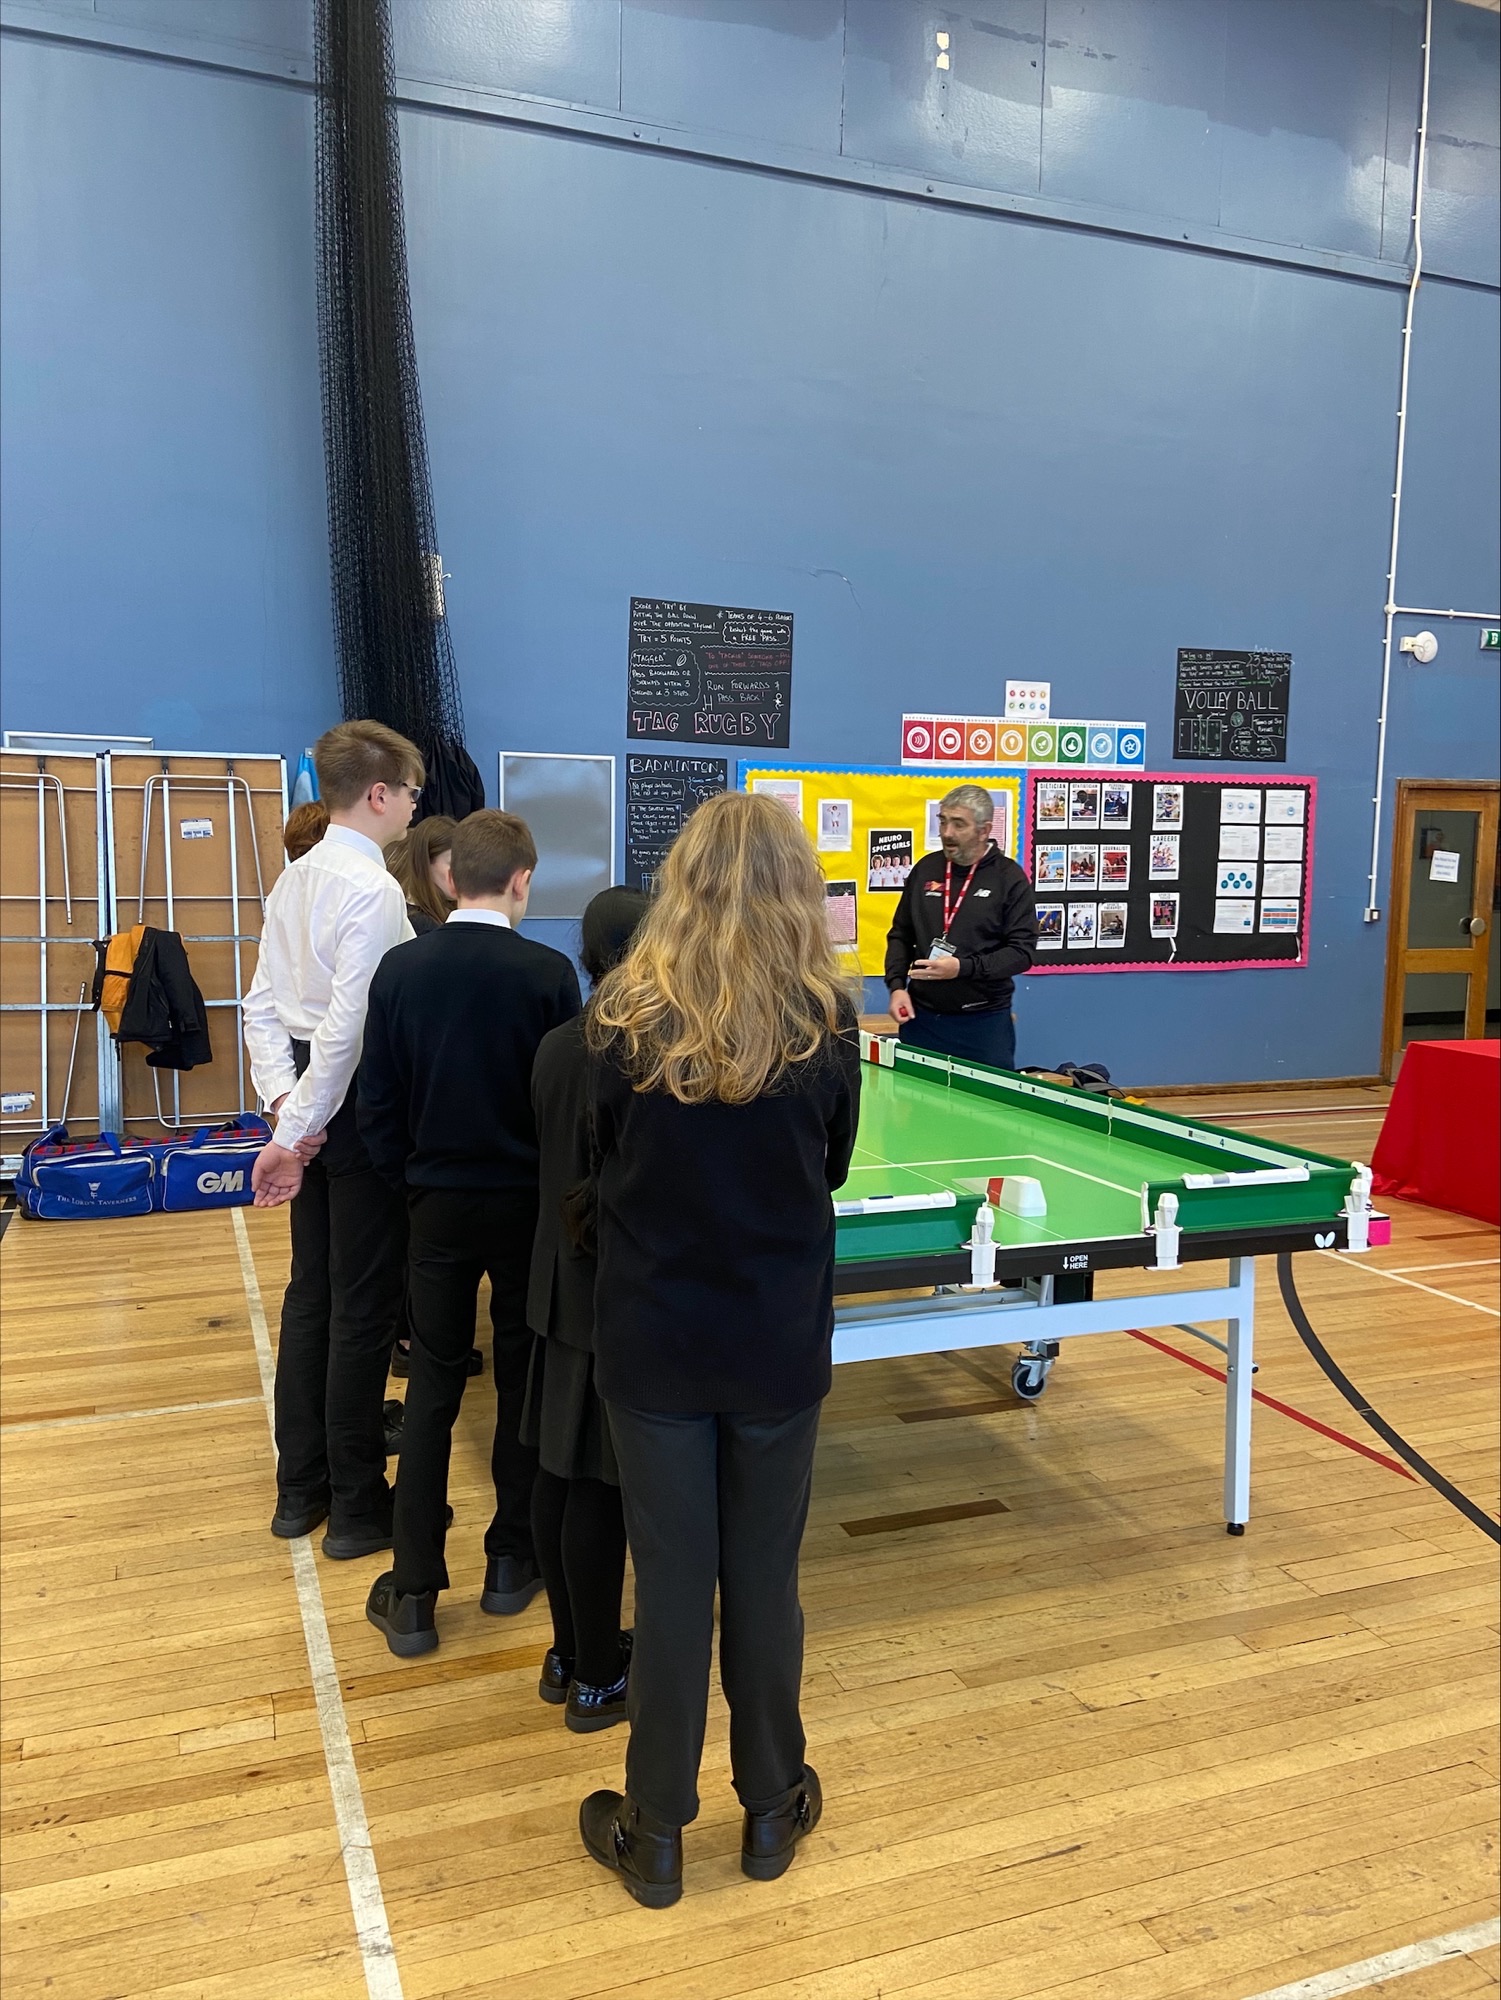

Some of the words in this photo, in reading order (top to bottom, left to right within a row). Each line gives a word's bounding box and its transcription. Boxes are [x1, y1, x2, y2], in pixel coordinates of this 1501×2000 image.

[725, 610, 745, 619] TEAMS
[637, 634, 652, 643] TRY
[660, 634, 667, 644] 5
[670, 634, 692, 645] POINTS
[706, 680, 724, 691] RUN
[730, 679, 770, 690] FORWARDS
[663, 688, 670, 697] 3
[718, 693, 734, 702] PASS
[1185, 690, 1231, 710] VOLLEY
[1237, 691, 1279, 710] BALL
[632, 710, 679, 733] TAG
[694, 711, 781, 740] RUGBY
[878, 834, 902, 844] NEURO
[872, 844, 891, 853] SPICE
[891, 841, 911, 850] GIRLS
[1220, 1138, 1225, 1147] 4
[197, 1170, 244, 1194] GM
[1070, 1254, 1089, 1262] OPEN
[1070, 1261, 1088, 1270] HERE
